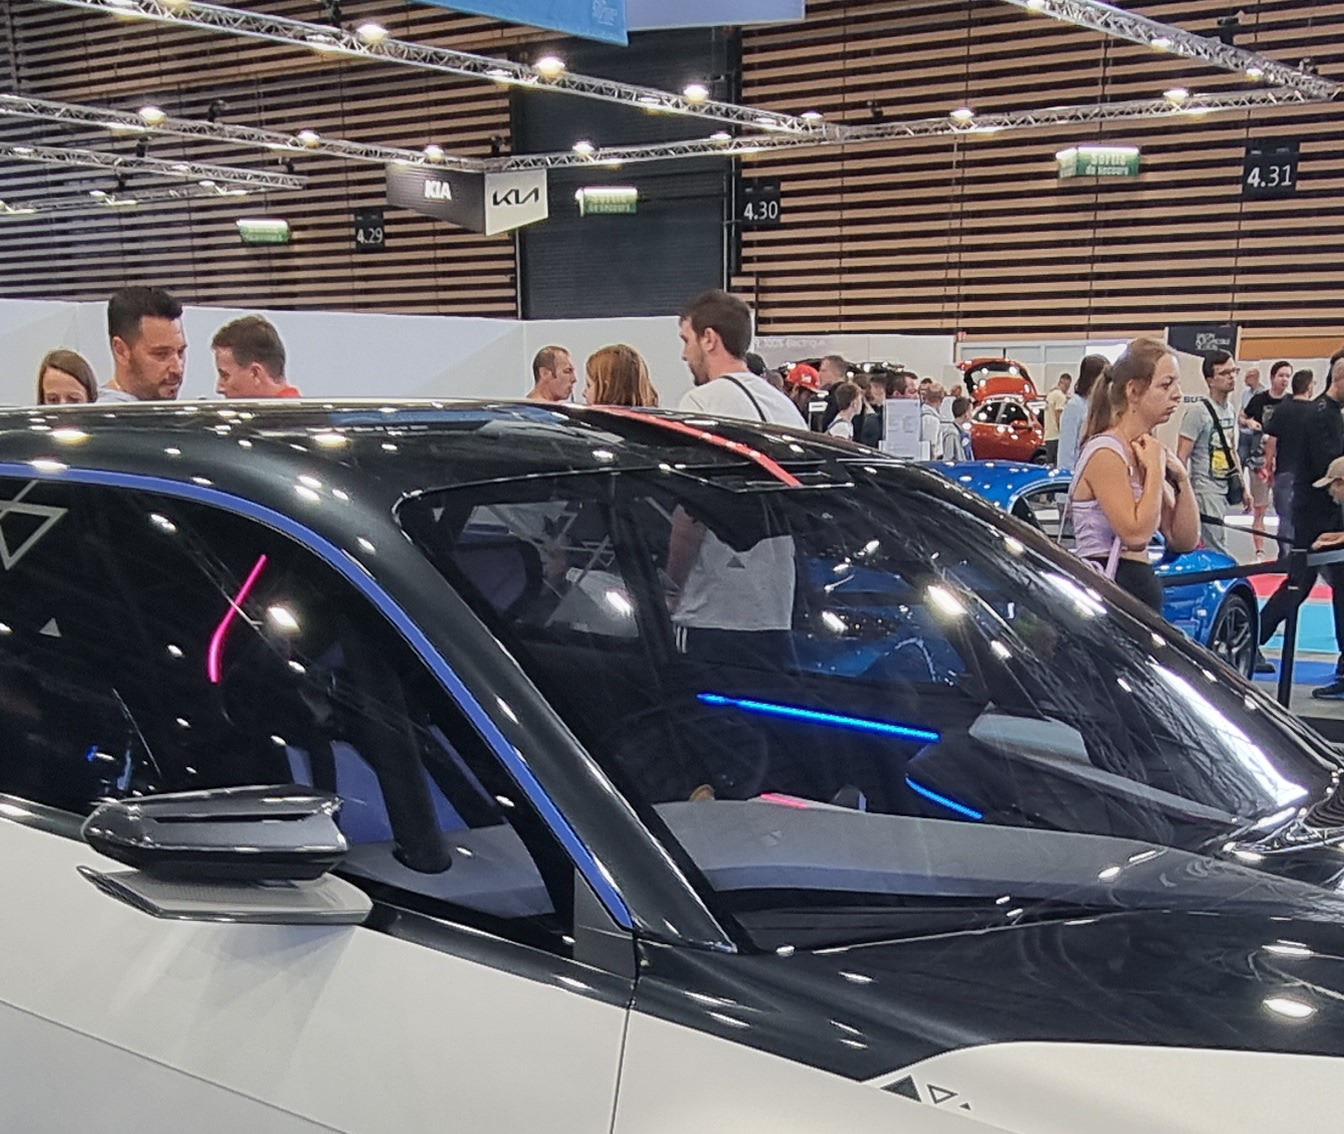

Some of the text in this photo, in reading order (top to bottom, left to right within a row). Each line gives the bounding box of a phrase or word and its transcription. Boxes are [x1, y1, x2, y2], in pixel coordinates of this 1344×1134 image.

[1247, 164, 1292, 187] 4.31
[424, 179, 452, 200] KIA
[744, 201, 778, 220] 4.30
[357, 228, 383, 244] 4.29
